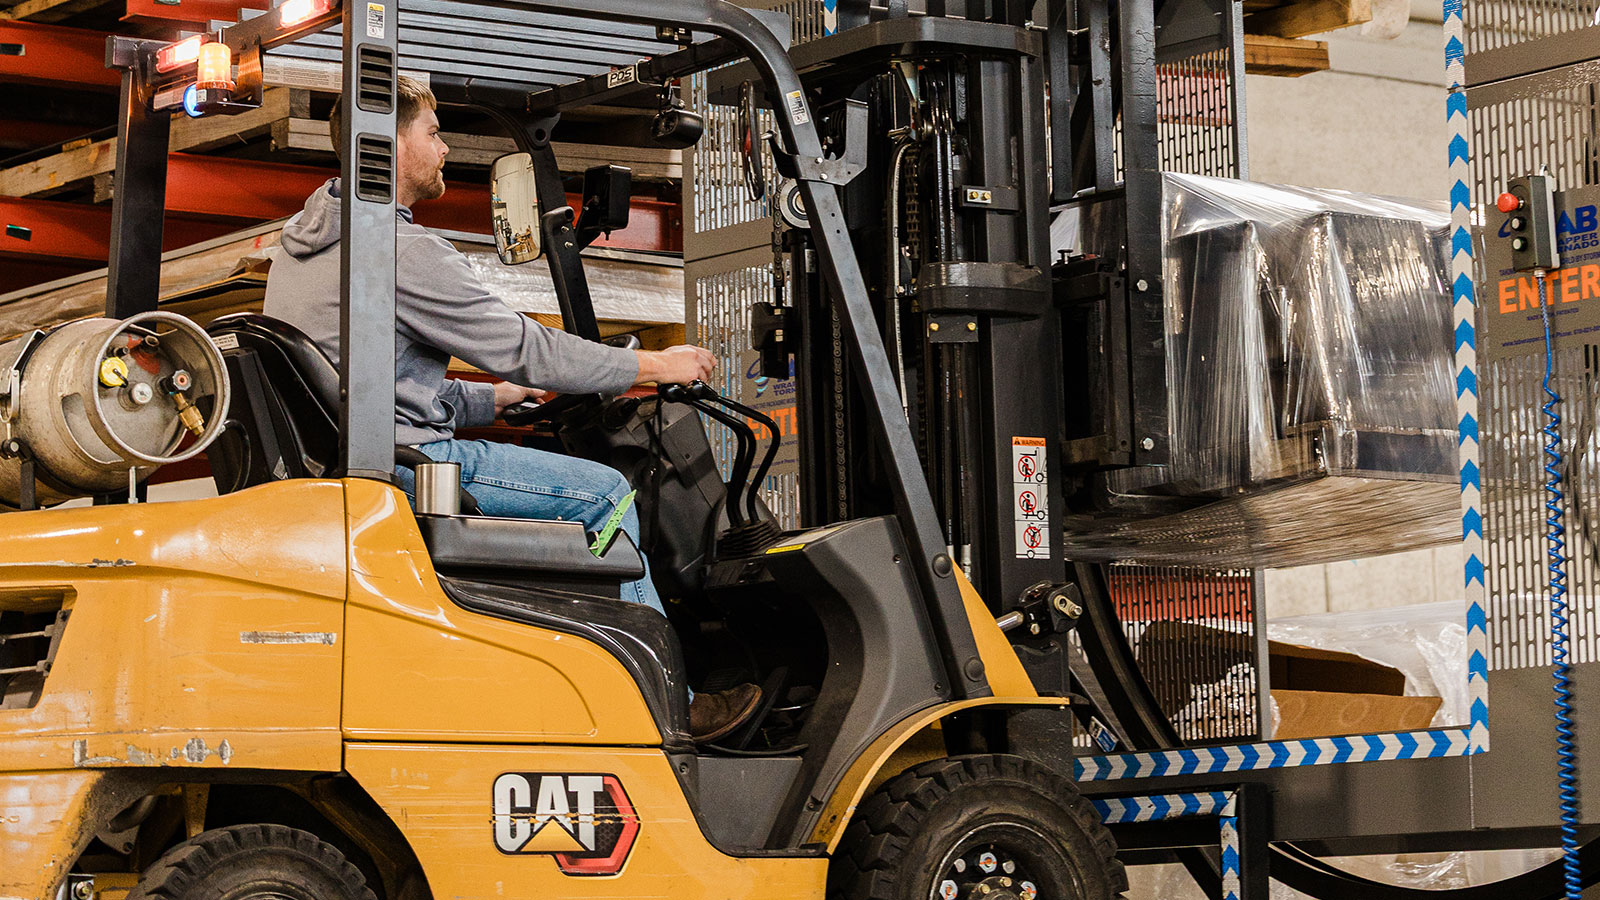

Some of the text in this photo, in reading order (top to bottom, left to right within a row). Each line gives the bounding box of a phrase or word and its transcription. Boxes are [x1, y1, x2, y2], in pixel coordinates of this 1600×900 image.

[1557, 205, 1598, 237] AB
[1558, 232, 1598, 247] APPER
[1498, 264, 1600, 314] ENTER
[494, 773, 604, 852] CAT
